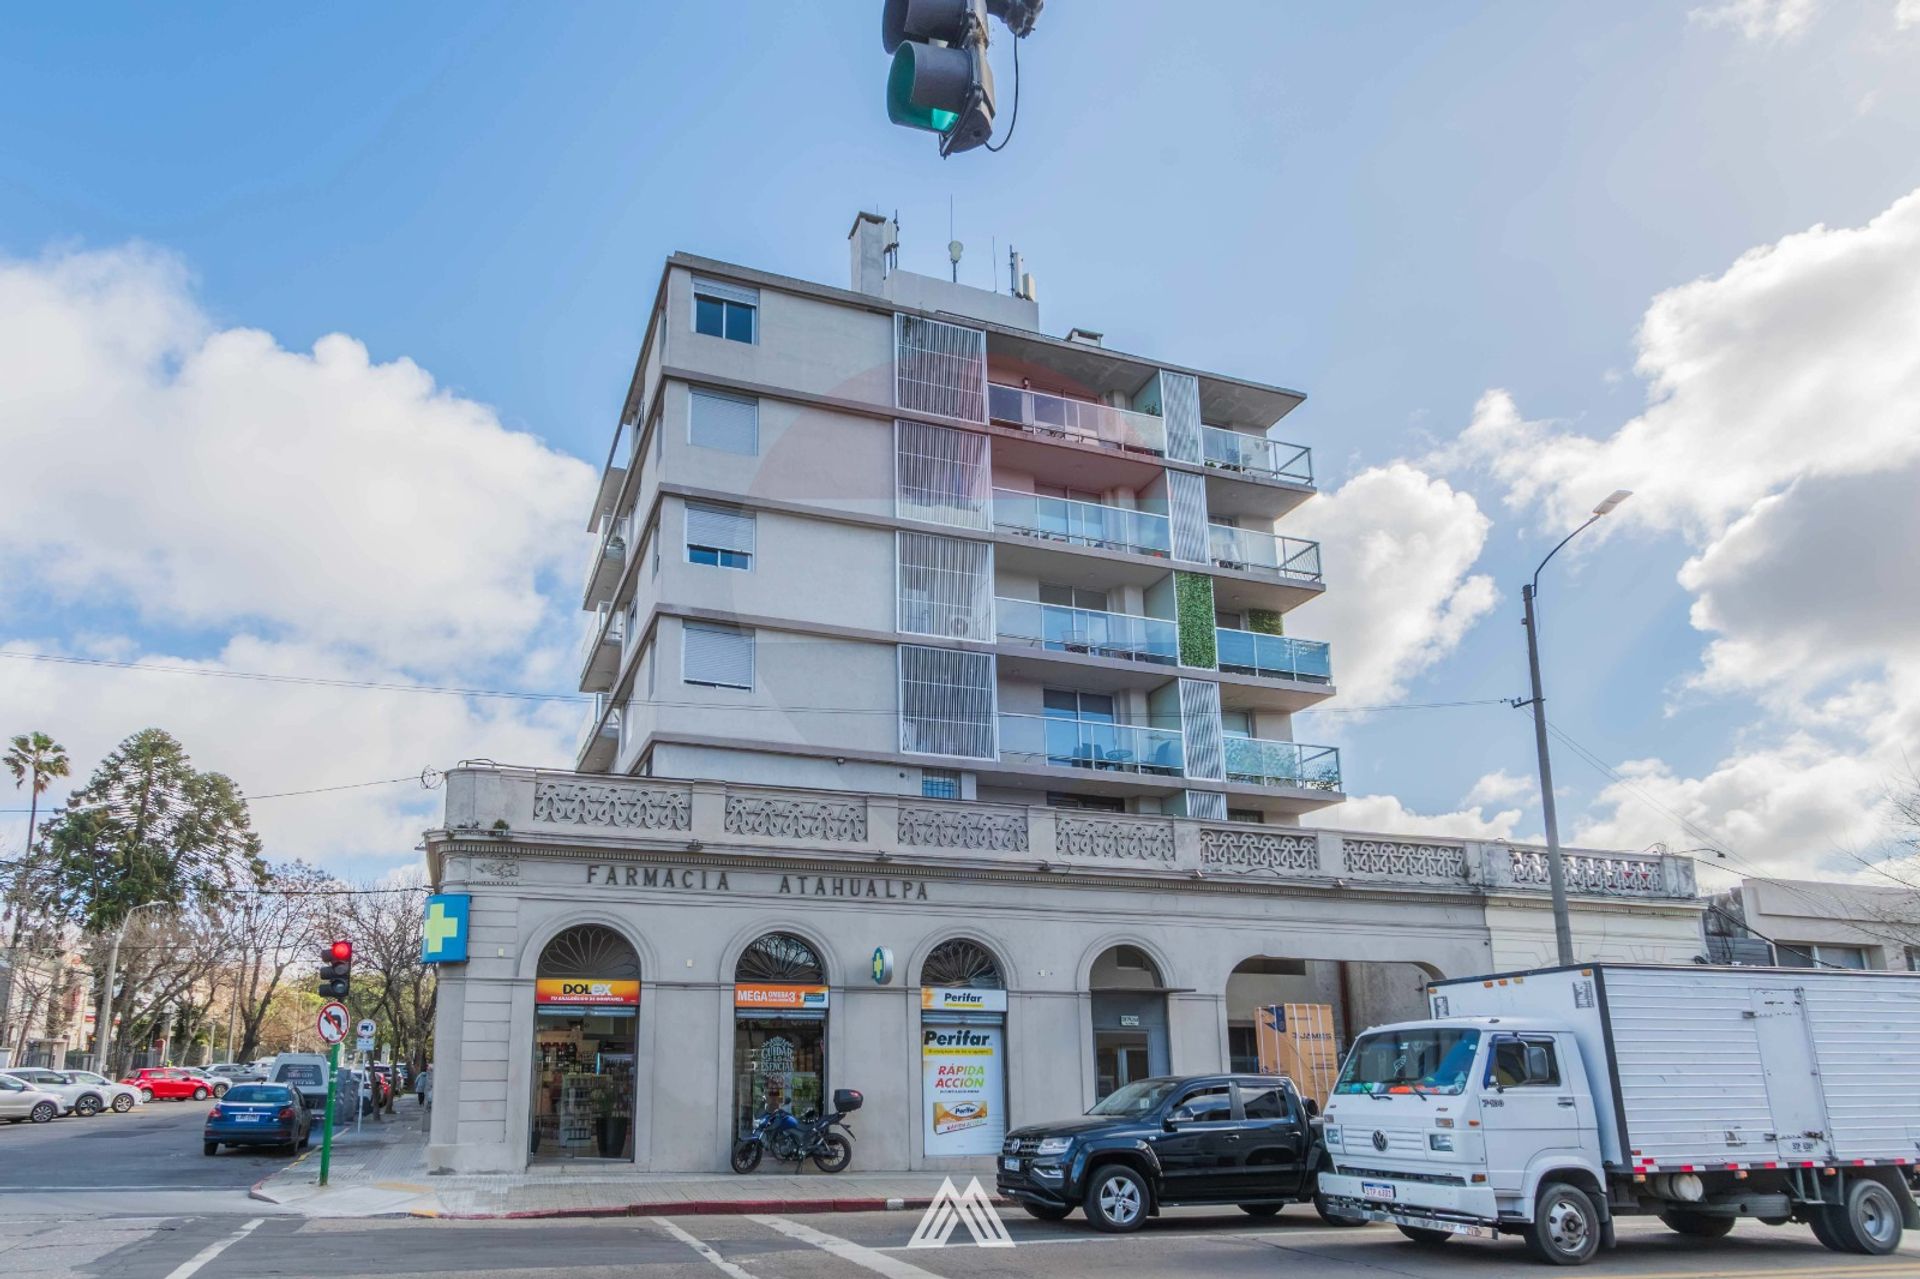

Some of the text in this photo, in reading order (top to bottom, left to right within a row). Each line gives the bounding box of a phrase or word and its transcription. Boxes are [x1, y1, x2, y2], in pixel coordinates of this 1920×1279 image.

[587, 865, 928, 900] FARMACIA ATAHUALPA
[738, 990, 767, 1002] MEGA
[944, 993, 982, 1003] Perifar
[924, 1030, 990, 1046] Perifar
[938, 1063, 984, 1075] RÁPIDA
